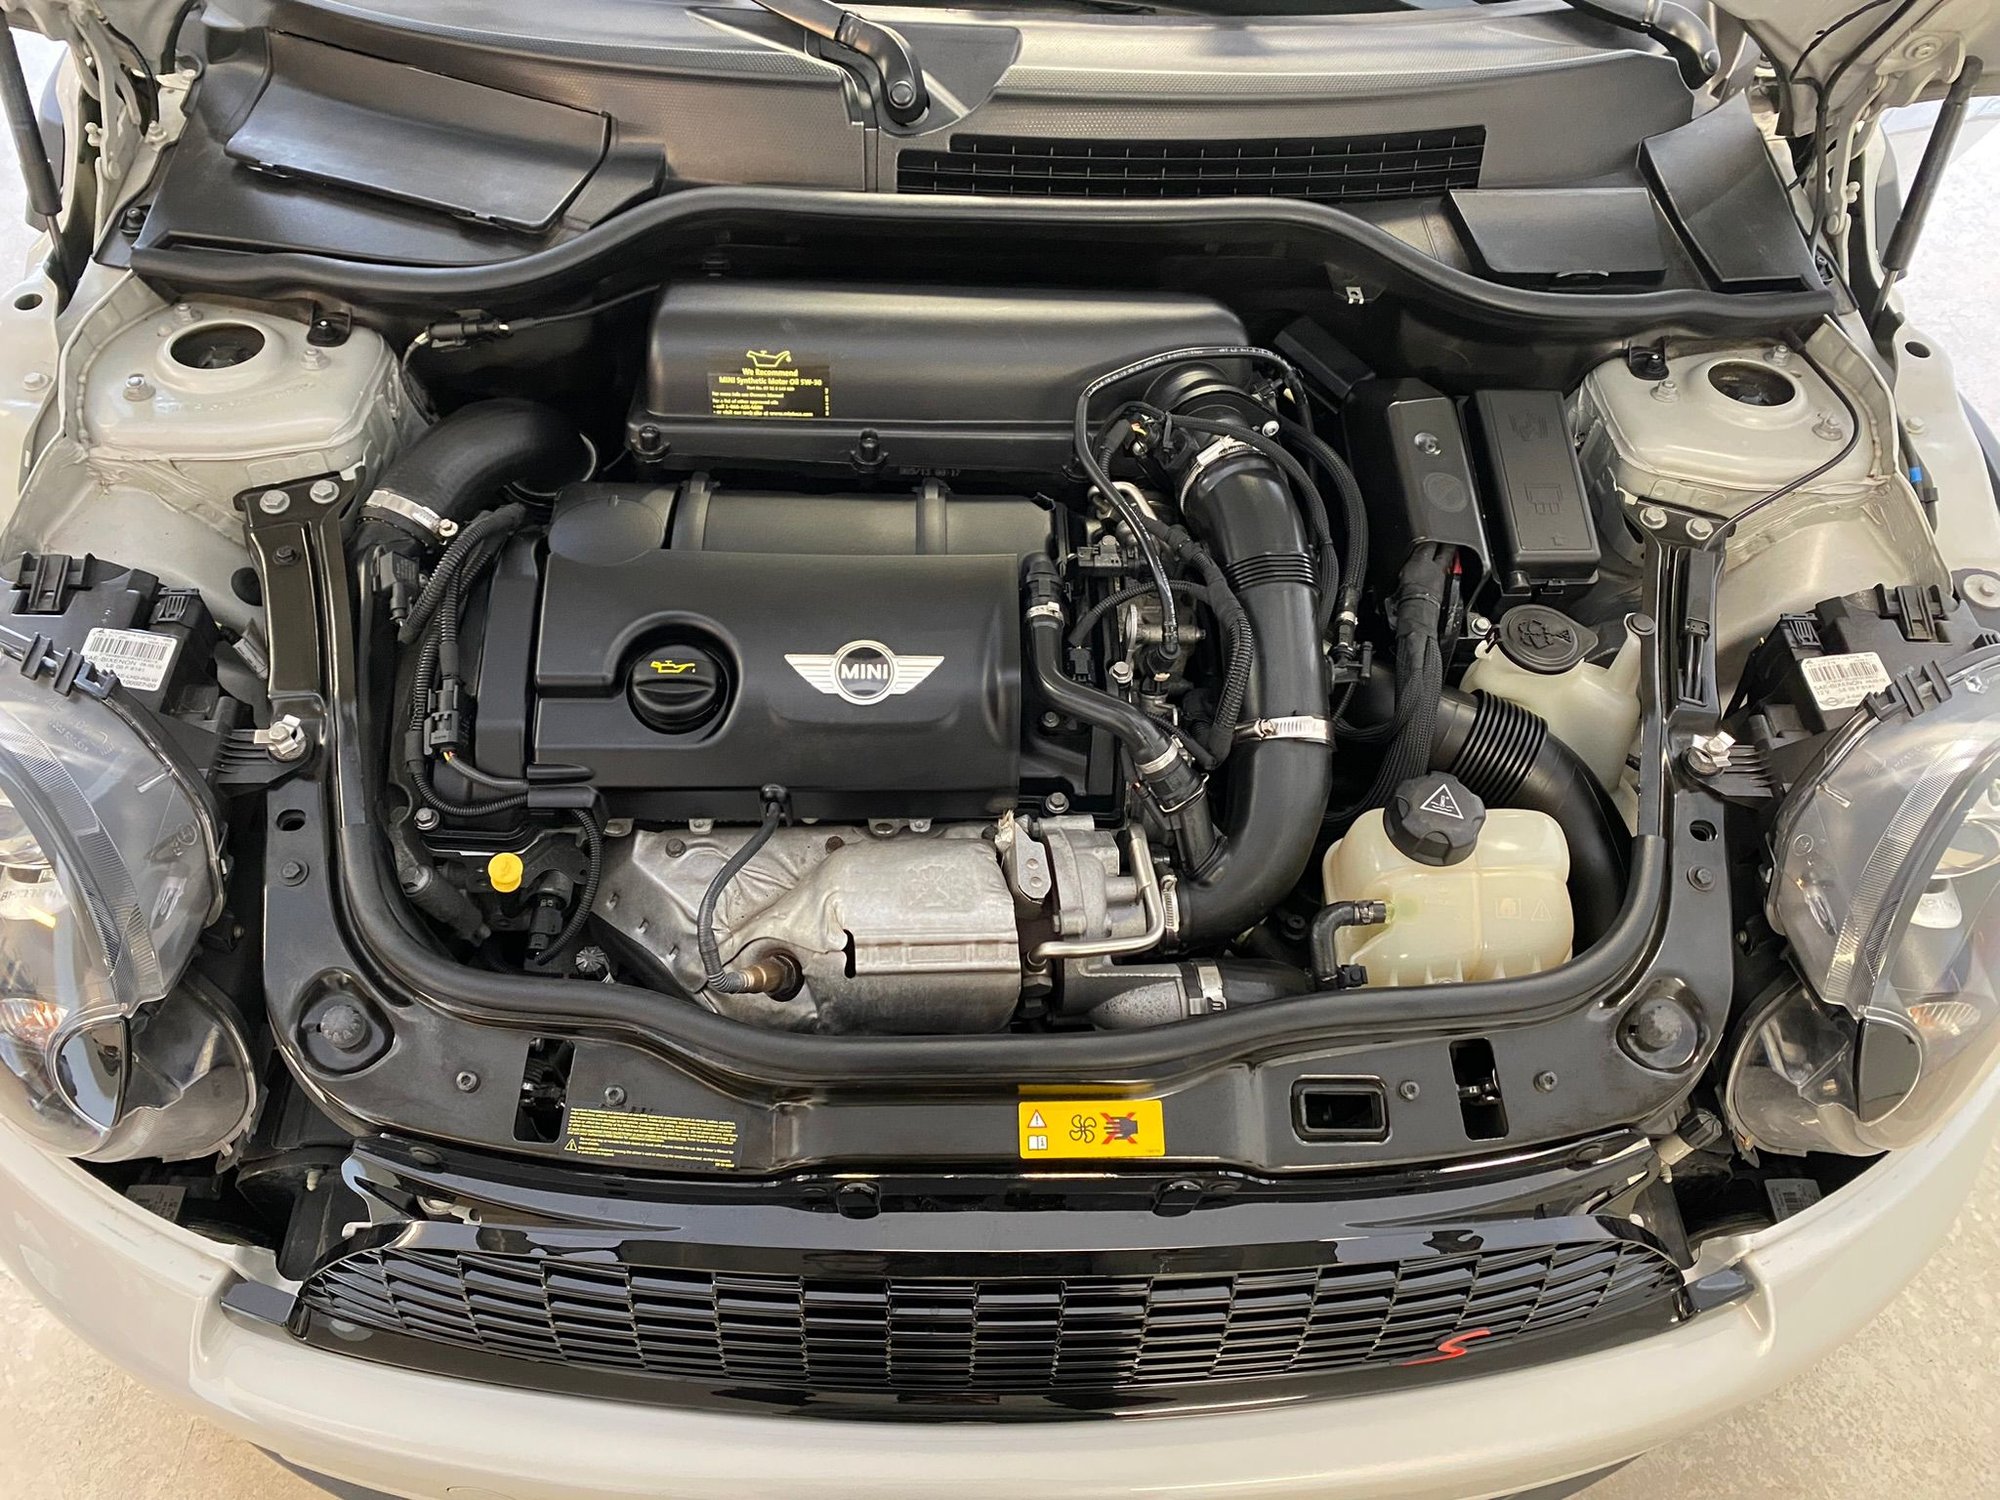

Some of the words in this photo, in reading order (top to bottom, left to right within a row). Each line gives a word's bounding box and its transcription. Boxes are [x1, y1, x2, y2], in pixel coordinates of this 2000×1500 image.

[755, 368, 798, 377] Recommend
[736, 377, 767, 386] Synthetic
[789, 378, 800, 386] Oil
[841, 664, 889, 679] MINI
